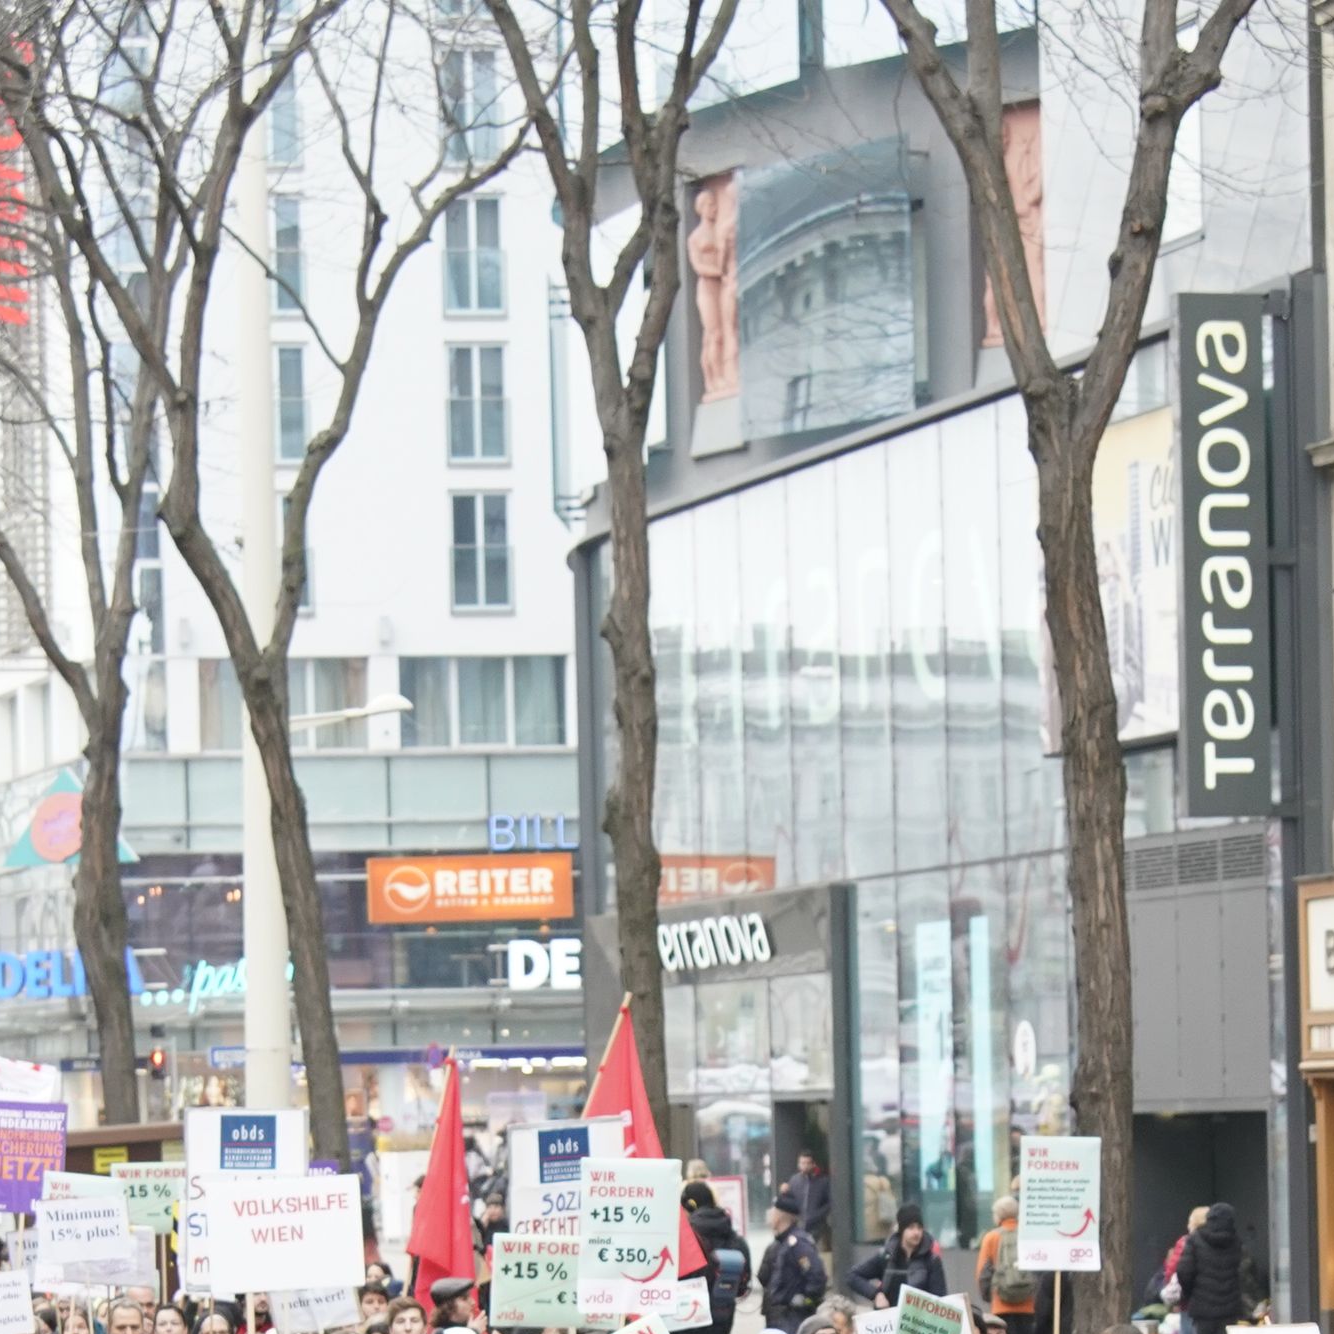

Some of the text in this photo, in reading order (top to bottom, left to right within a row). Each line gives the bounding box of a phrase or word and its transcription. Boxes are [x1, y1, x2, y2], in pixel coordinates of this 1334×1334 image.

[435, 867, 554, 896] REITER
[659, 912, 773, 974] erranova
[231, 1124, 265, 1141] obds
[549, 1138, 579, 1155] obds
[1027, 1148, 1049, 1157] WIR
[117, 1168, 142, 1179] WIR
[1027, 1160, 1079, 1171] FORDERN
[590, 1171, 616, 1182] WIR
[50, 1182, 71, 1191] WIR
[154, 1184, 172, 1198] %
[590, 1186, 654, 1198] FORDERN
[233, 1193, 349, 1217] VOLKSHILFE
[46, 1206, 120, 1223] Minimum:
[590, 1206, 650, 1223] +15 %
[51, 1224, 121, 1242] 15% plus!
[251, 1225, 304, 1245] WIEN
[588, 1236, 613, 1246] mind.
[501, 1241, 532, 1254] WIR
[1069, 1248, 1093, 1263] gpa
[598, 1247, 659, 1266] € 350,-
[501, 1262, 568, 1280] +15 %
[313, 1289, 348, 1308] wert!
[557, 1291, 567, 1304] €
[585, 1289, 613, 1304] vida
[639, 1288, 672, 1306] gpa
[496, 1308, 525, 1322] vida
[921, 1300, 963, 1324] FORDERN
